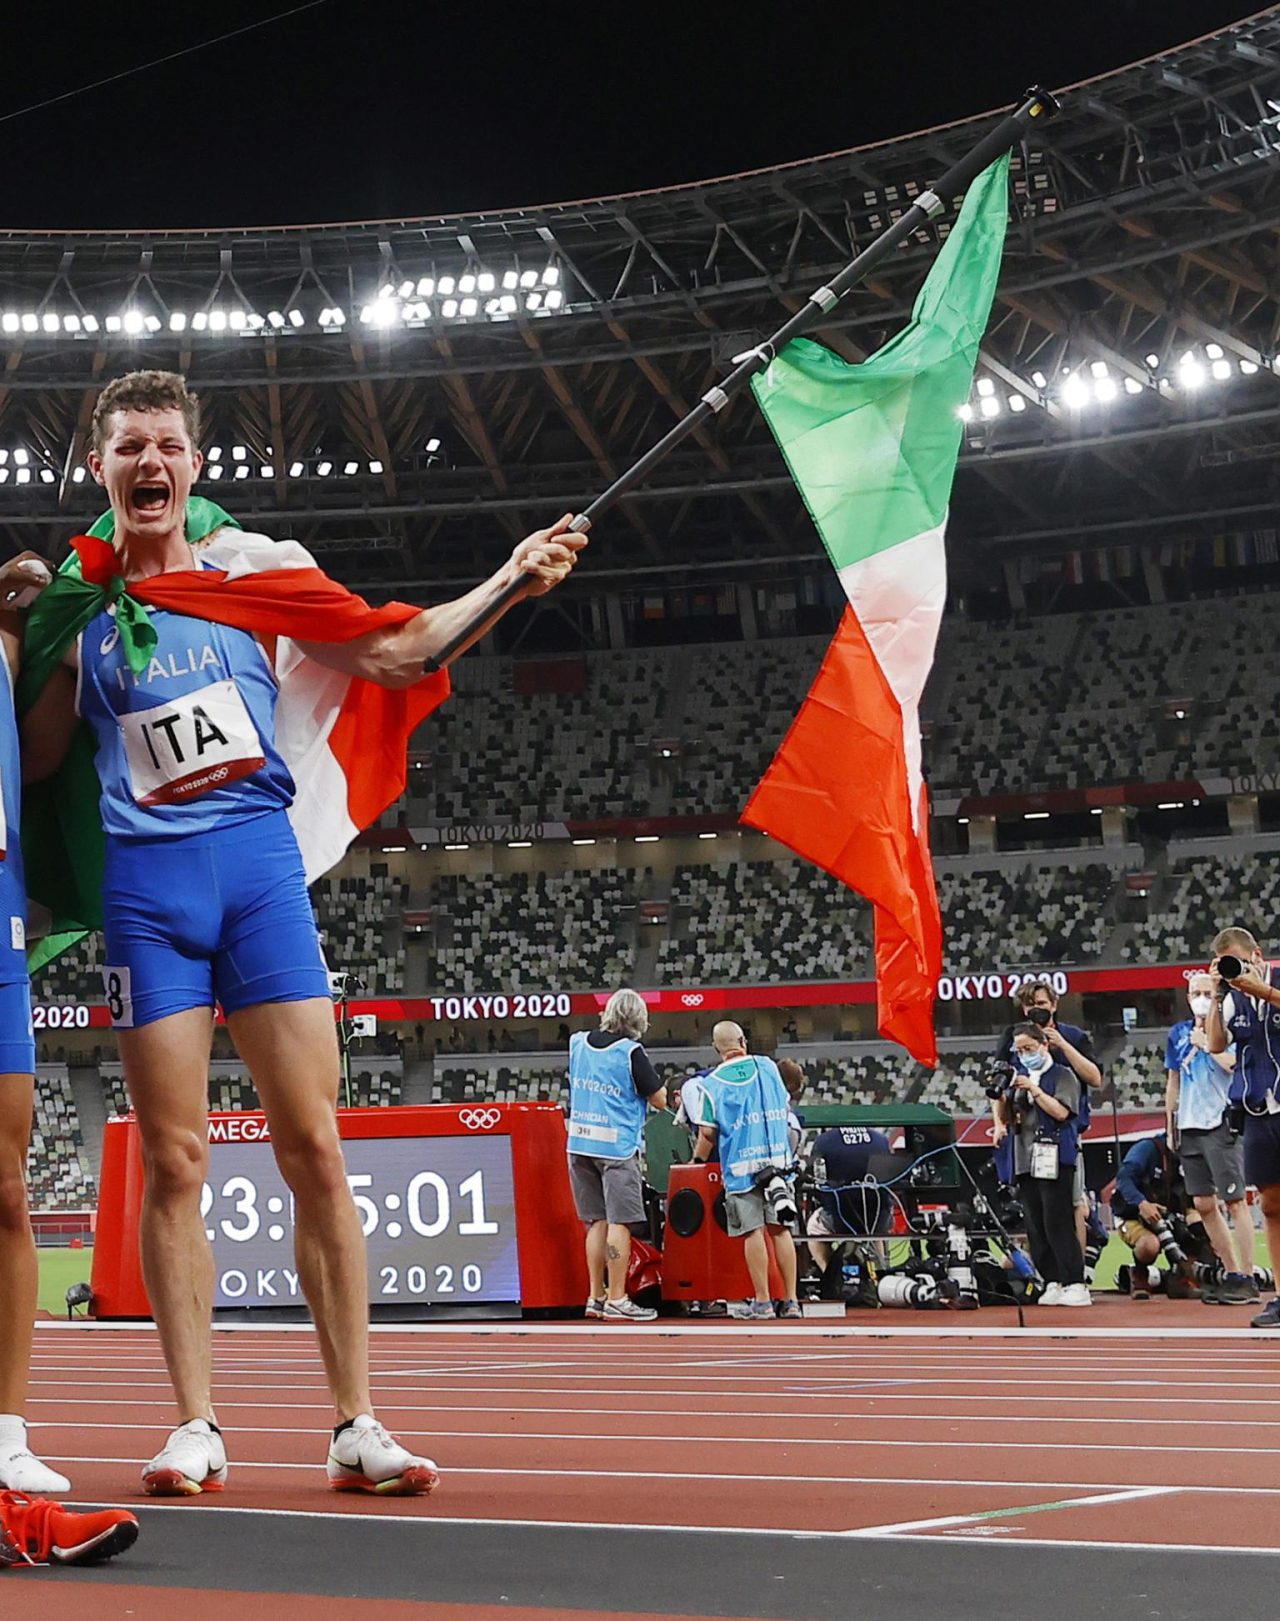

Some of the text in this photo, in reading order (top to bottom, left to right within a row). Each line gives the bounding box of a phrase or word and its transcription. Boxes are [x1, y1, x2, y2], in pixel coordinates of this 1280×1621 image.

[140, 704, 229, 769] ITA
[437, 823, 544, 843] TOKYO 2020
[108, 972, 124, 1020] 8
[937, 975, 1003, 1000] OKYO
[33, 1005, 90, 1028] 2020
[430, 993, 570, 1020] TOKYO 2020
[207, 1120, 271, 1142] MEGA
[843, 1133, 871, 1145] G278
[199, 1170, 498, 1242] 23:5:01
[220, 1264, 482, 1297] OKY 2020
